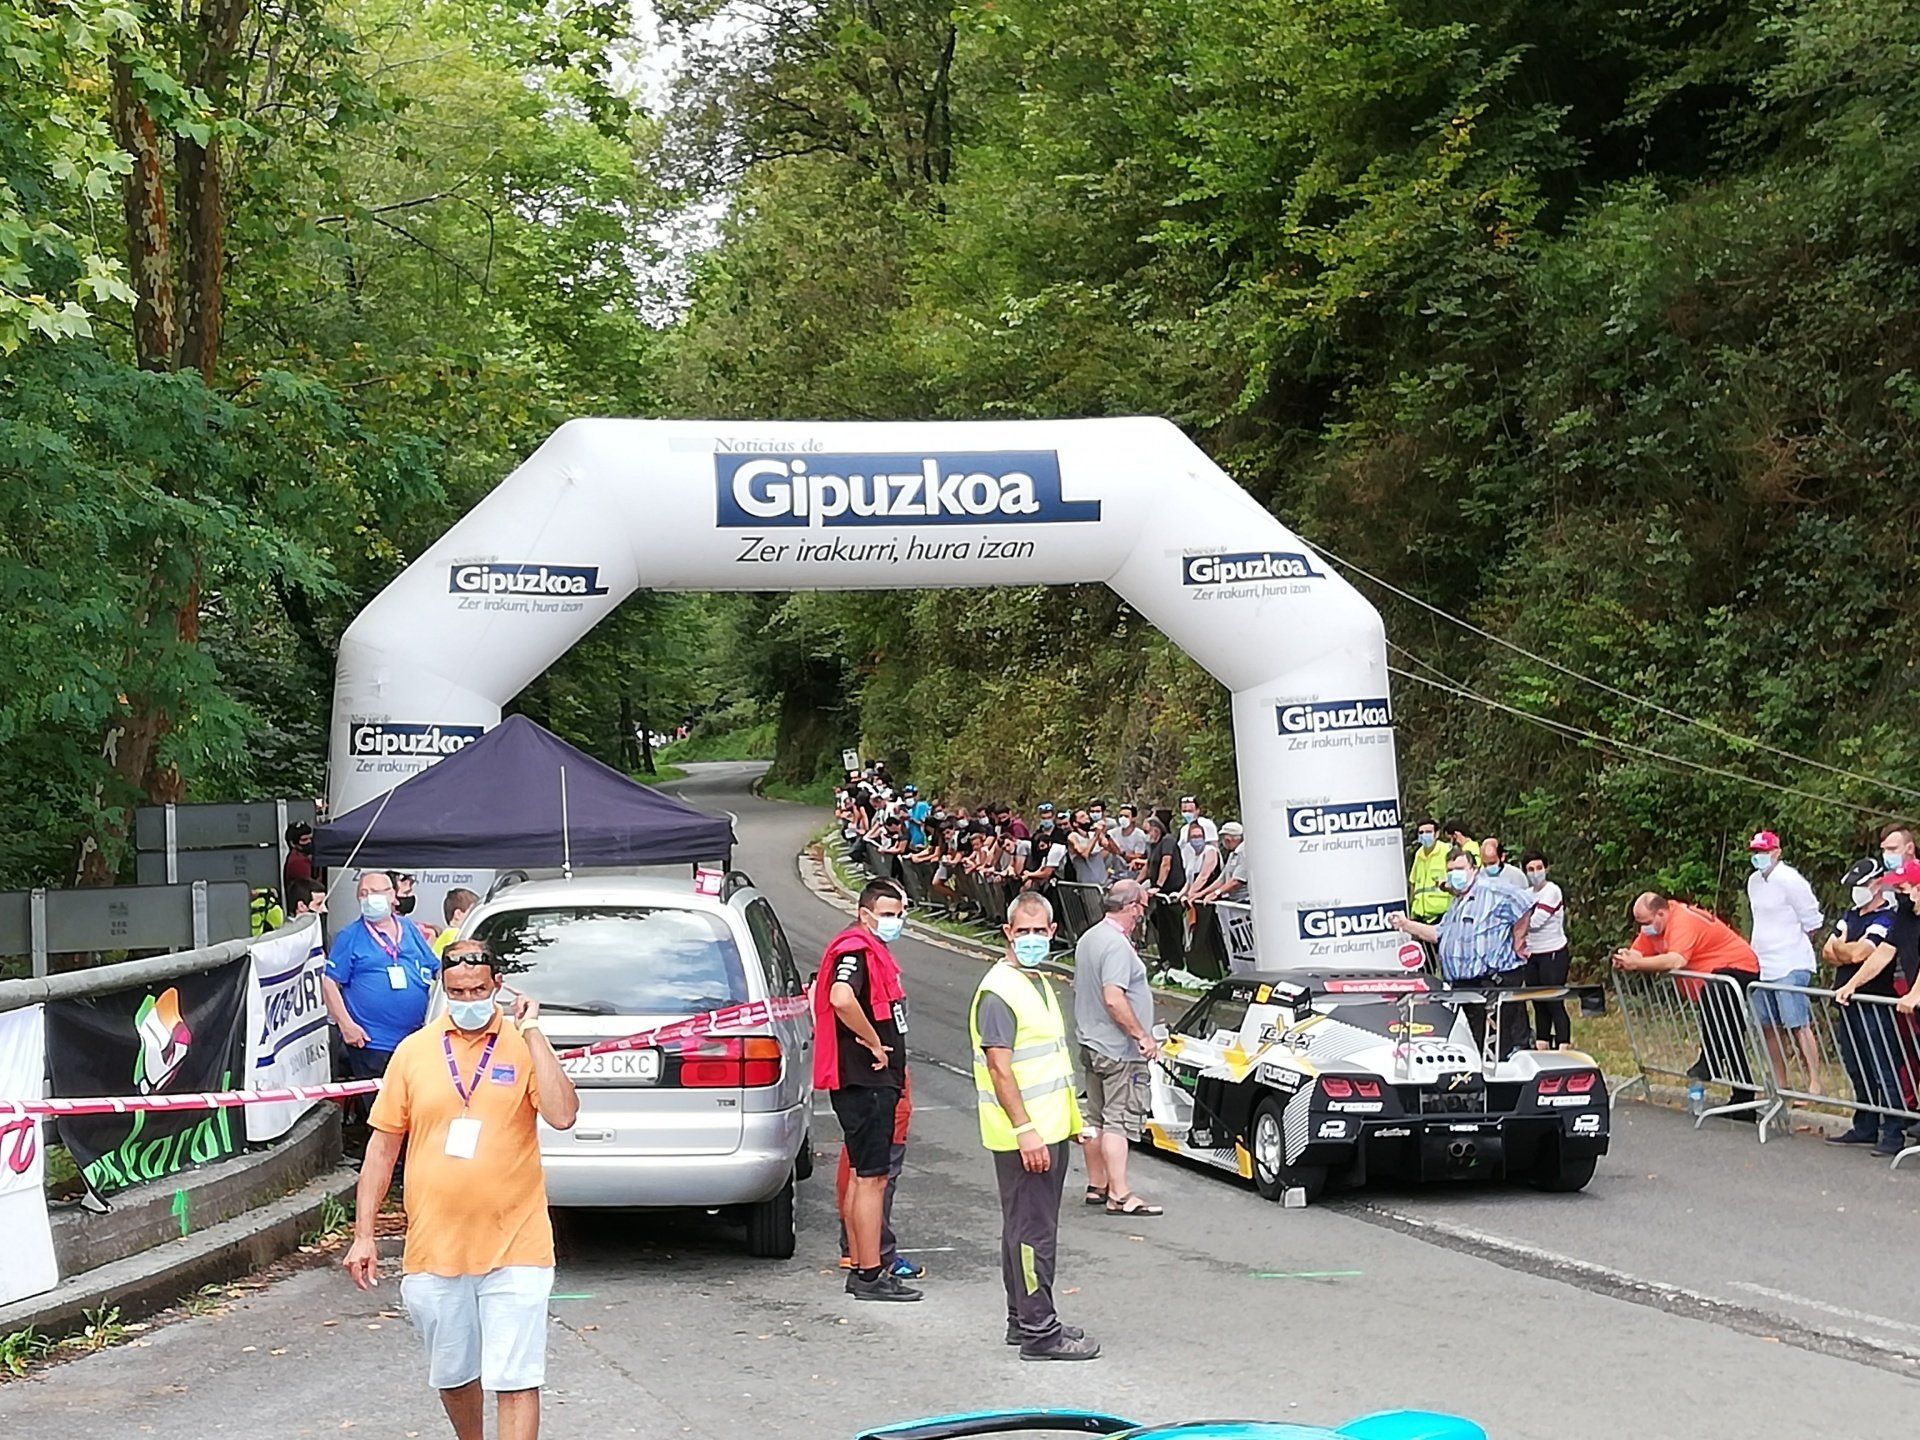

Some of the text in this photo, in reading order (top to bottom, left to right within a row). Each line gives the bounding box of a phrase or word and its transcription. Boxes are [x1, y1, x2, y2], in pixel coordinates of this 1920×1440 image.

[714, 437, 824, 453] Noticias de
[732, 458, 1040, 528] Gipuzkoa
[736, 535, 1035, 564] Zer irakurri, hura izan
[1189, 554, 1307, 584] Gipuzkoa
[456, 566, 587, 596] Gipuzkoa
[1192, 588, 1214, 601] Zer
[1262, 584, 1287, 597] hura
[457, 596, 481, 610] Zer
[532, 601, 558, 613] hura
[1282, 702, 1388, 734] Gipuzkoa
[1288, 737, 1309, 751] Zer
[356, 760, 374, 772] Zer
[1293, 805, 1398, 836] Gipuzkoa
[1299, 840, 1319, 853] Zer
[1303, 906, 1405, 938] Gipuzk
[1309, 942, 1329, 955] Zer
[562, 1055, 650, 1073] 223 CKC
